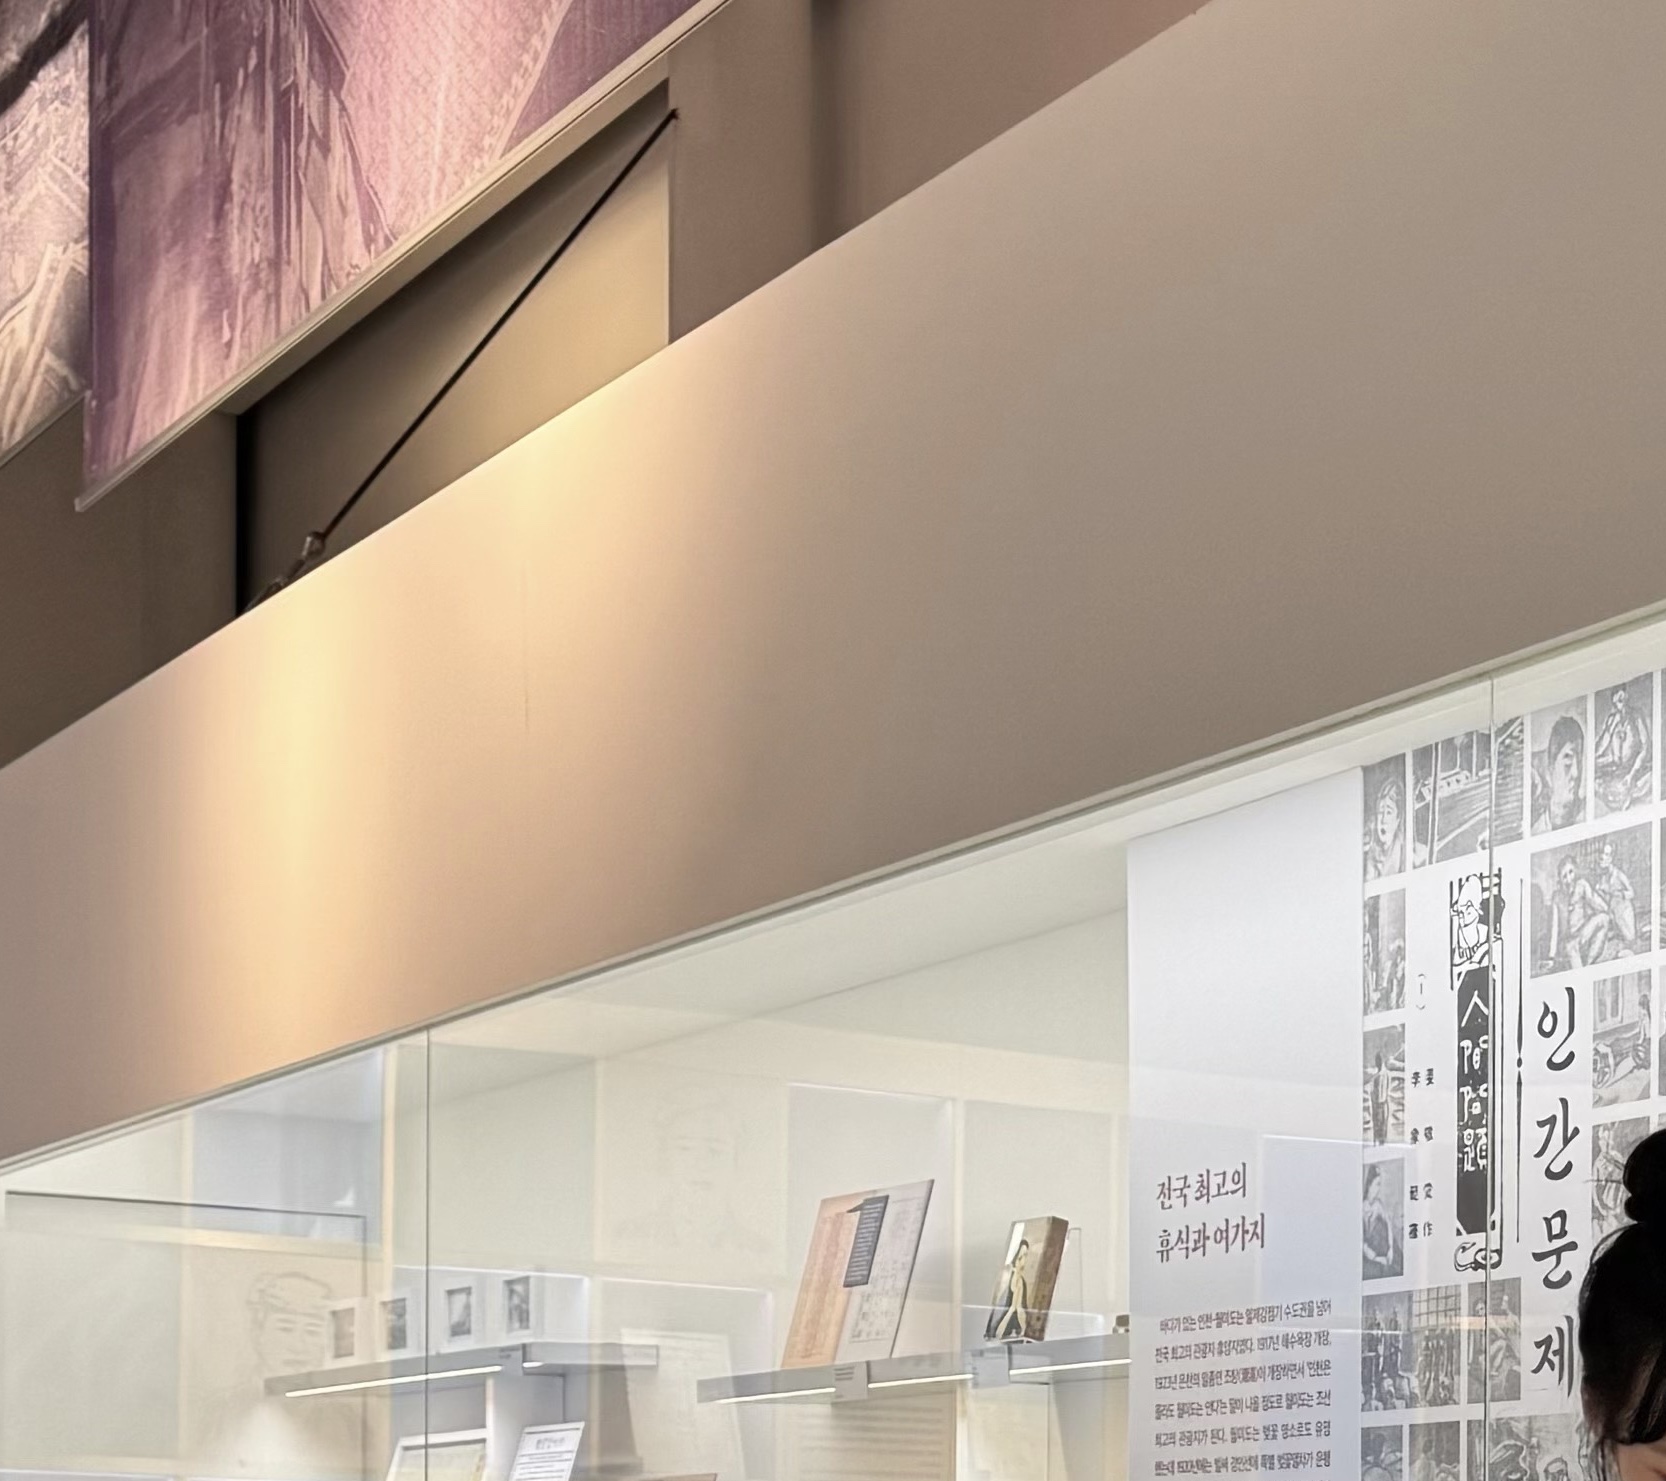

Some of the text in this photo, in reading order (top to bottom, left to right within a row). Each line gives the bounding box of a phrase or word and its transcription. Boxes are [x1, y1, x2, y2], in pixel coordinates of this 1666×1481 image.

[1155, 1161, 1247, 1211] 전국 최고의
[1155, 1212, 1265, 1264] 휴식과 여가지
